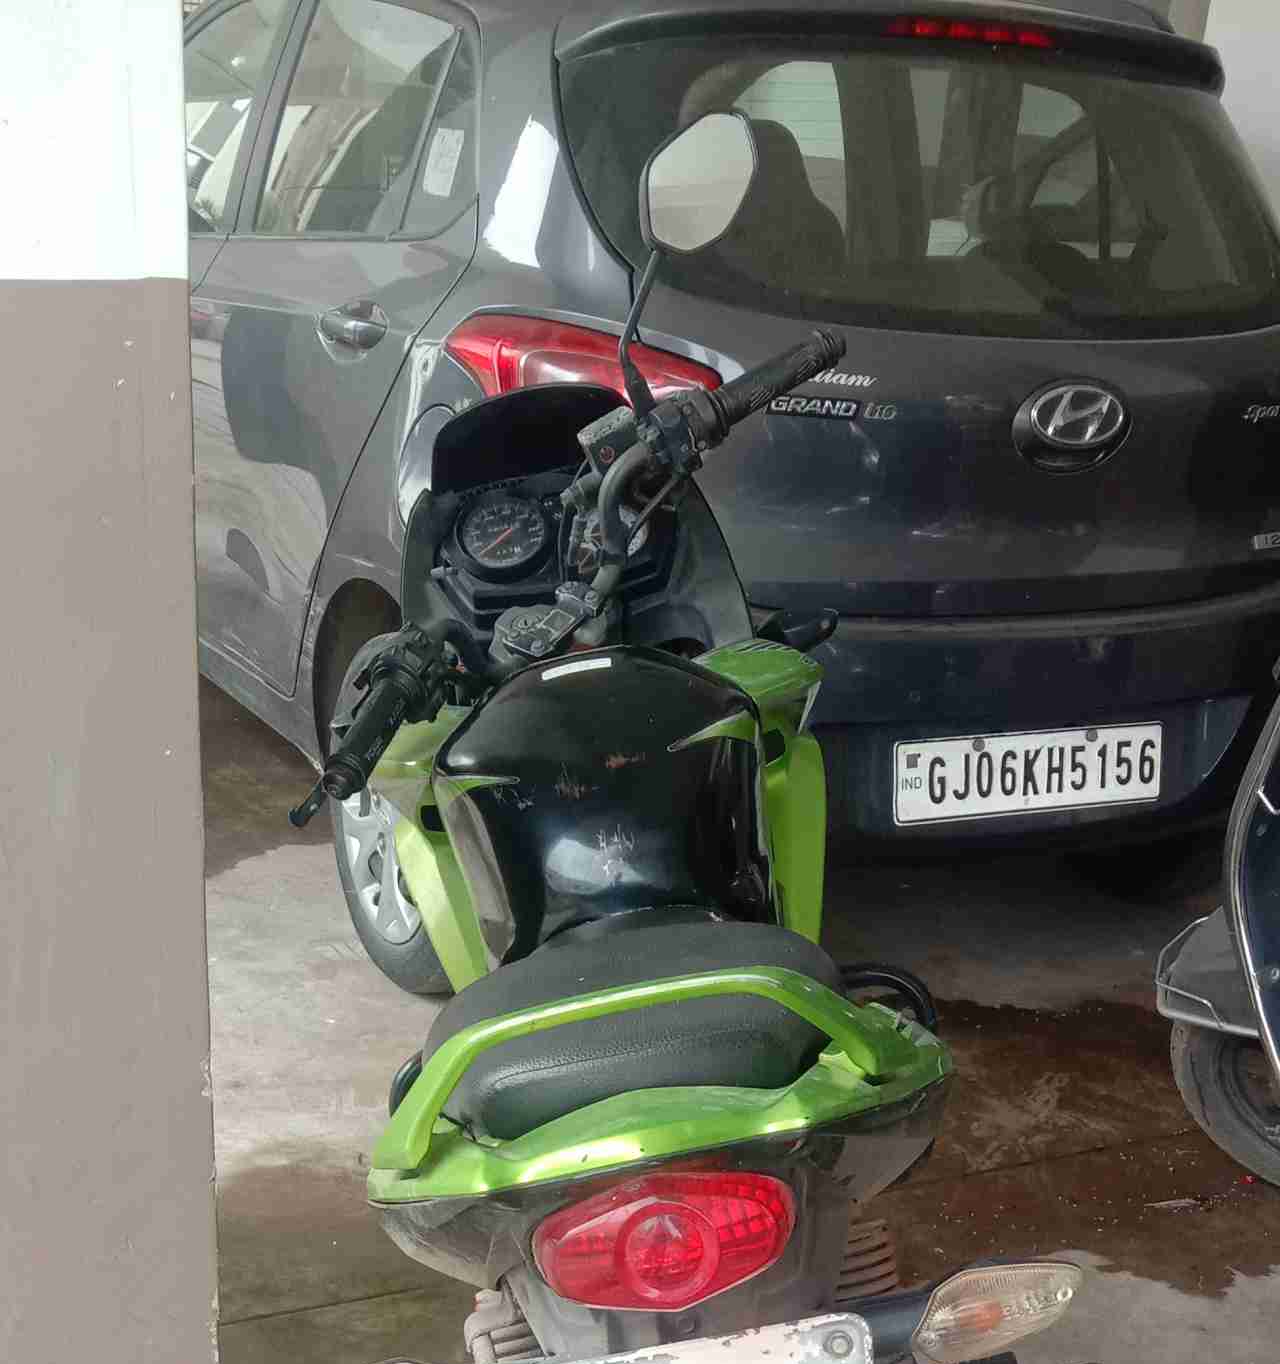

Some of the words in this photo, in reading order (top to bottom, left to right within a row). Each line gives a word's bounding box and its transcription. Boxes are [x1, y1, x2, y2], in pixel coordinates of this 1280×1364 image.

[770, 396, 857, 417] GRAND
[928, 739, 1156, 805] GJ06KH5156
[901, 776, 923, 791] IND
